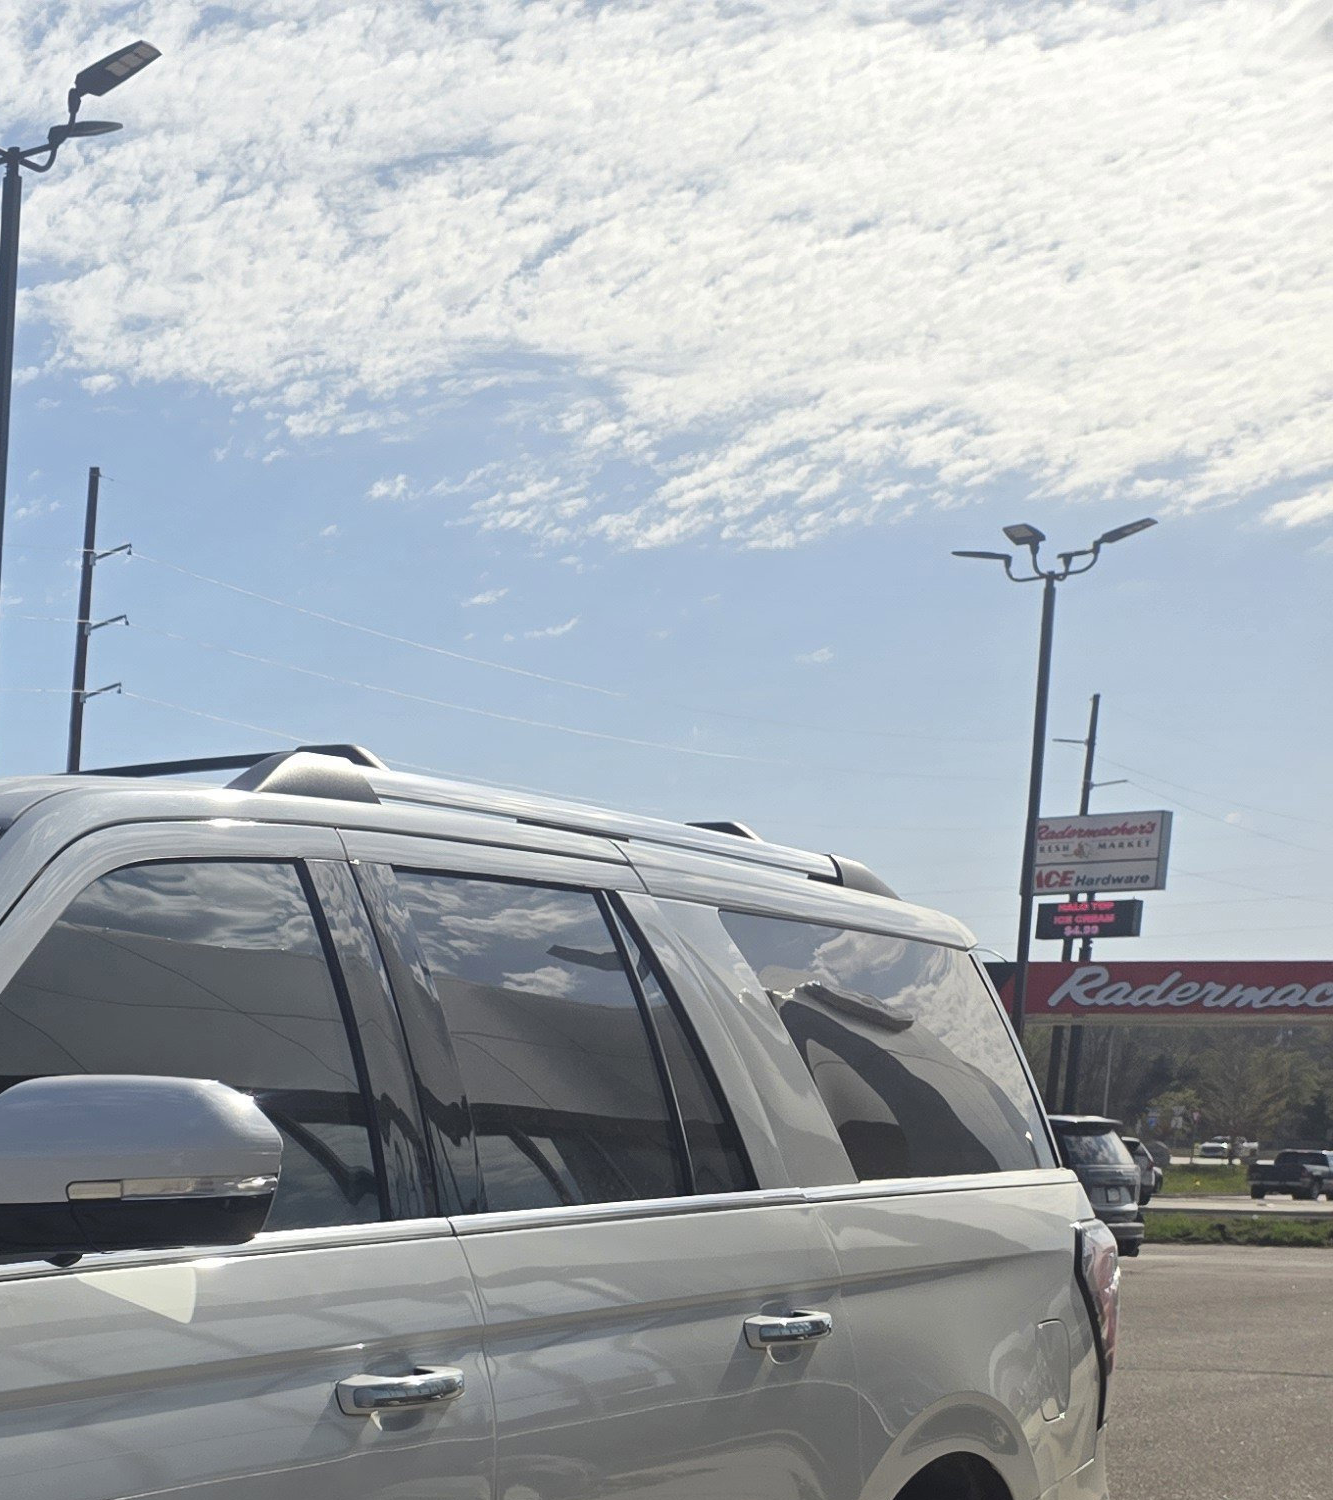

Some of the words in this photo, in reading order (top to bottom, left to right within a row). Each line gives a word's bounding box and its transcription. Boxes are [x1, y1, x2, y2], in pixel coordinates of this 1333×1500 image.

[1038, 843, 1070, 854] RESH
[1097, 839, 1151, 850] MARKET
[1074, 873, 1150, 887] Hardware
